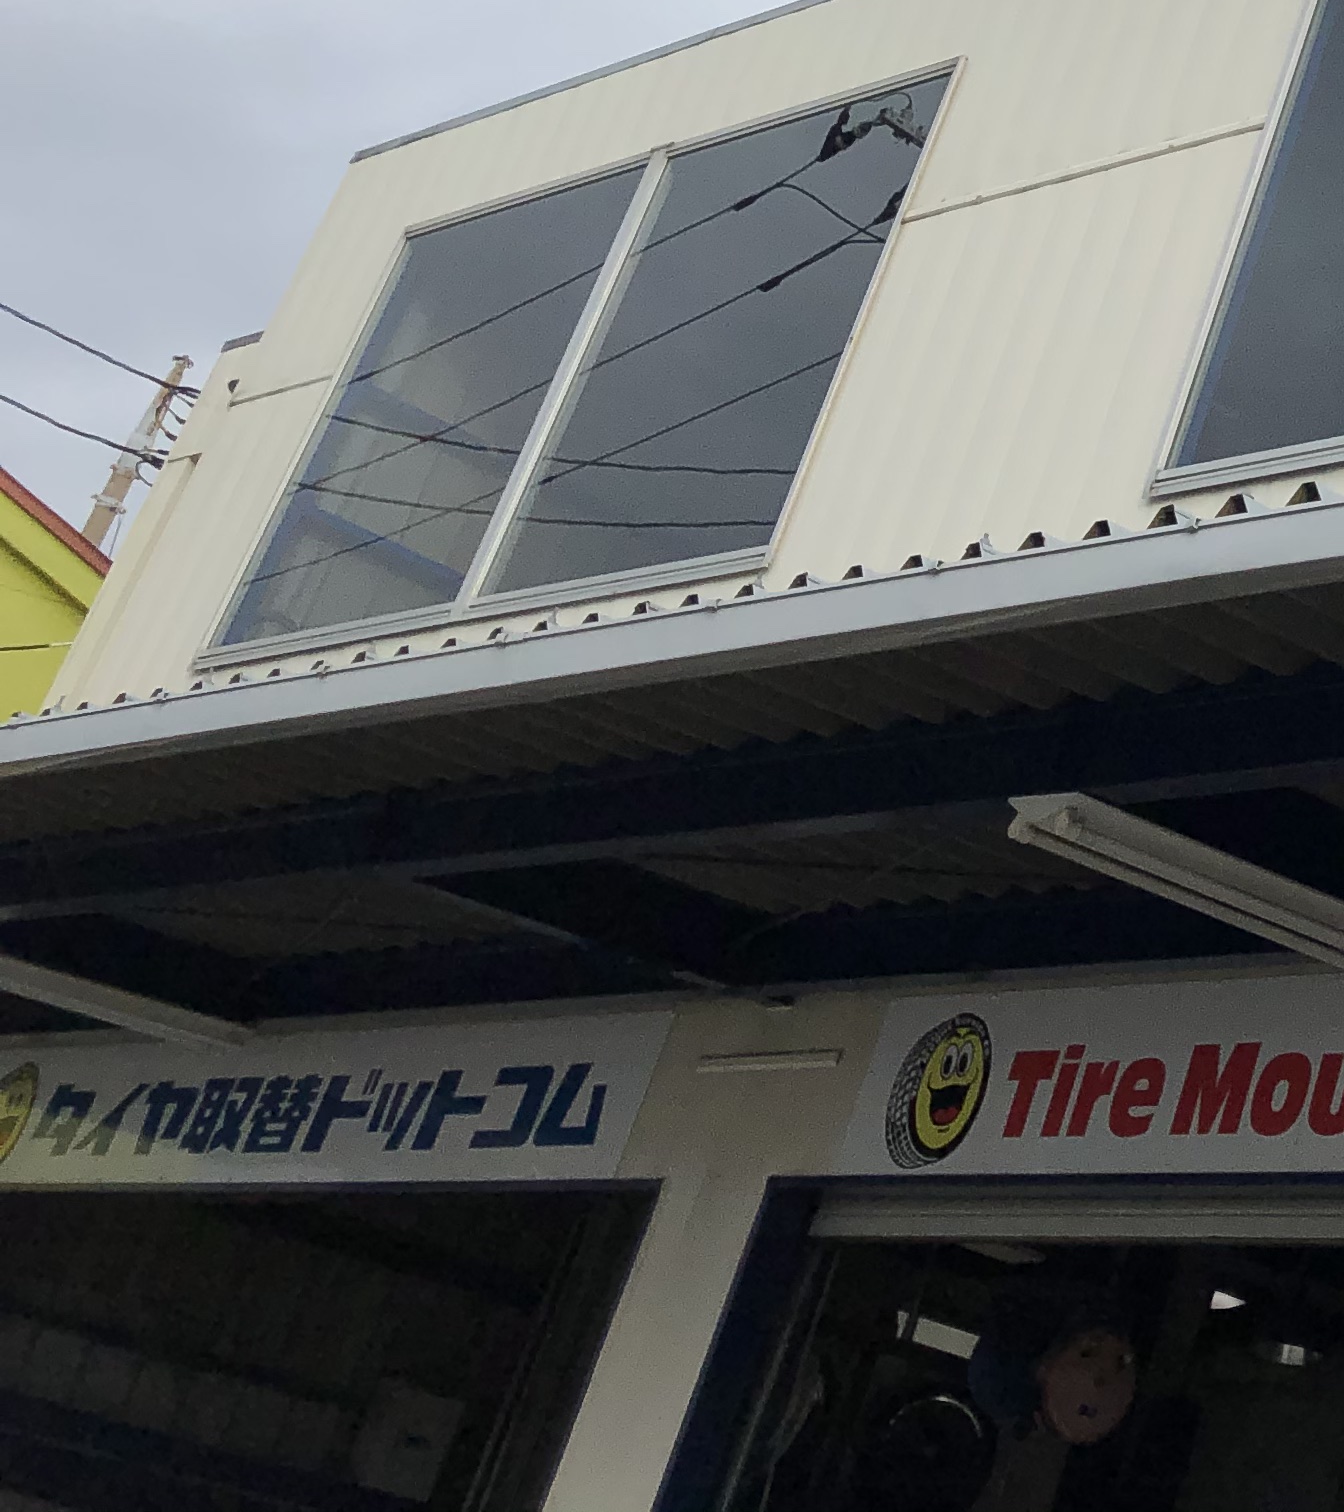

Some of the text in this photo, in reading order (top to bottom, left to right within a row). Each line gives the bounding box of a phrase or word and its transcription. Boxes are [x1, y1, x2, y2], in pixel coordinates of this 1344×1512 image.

[32, 1062, 607, 1157] タイヤ取替ドットコム
[1002, 1043, 1166, 1138] Tire
